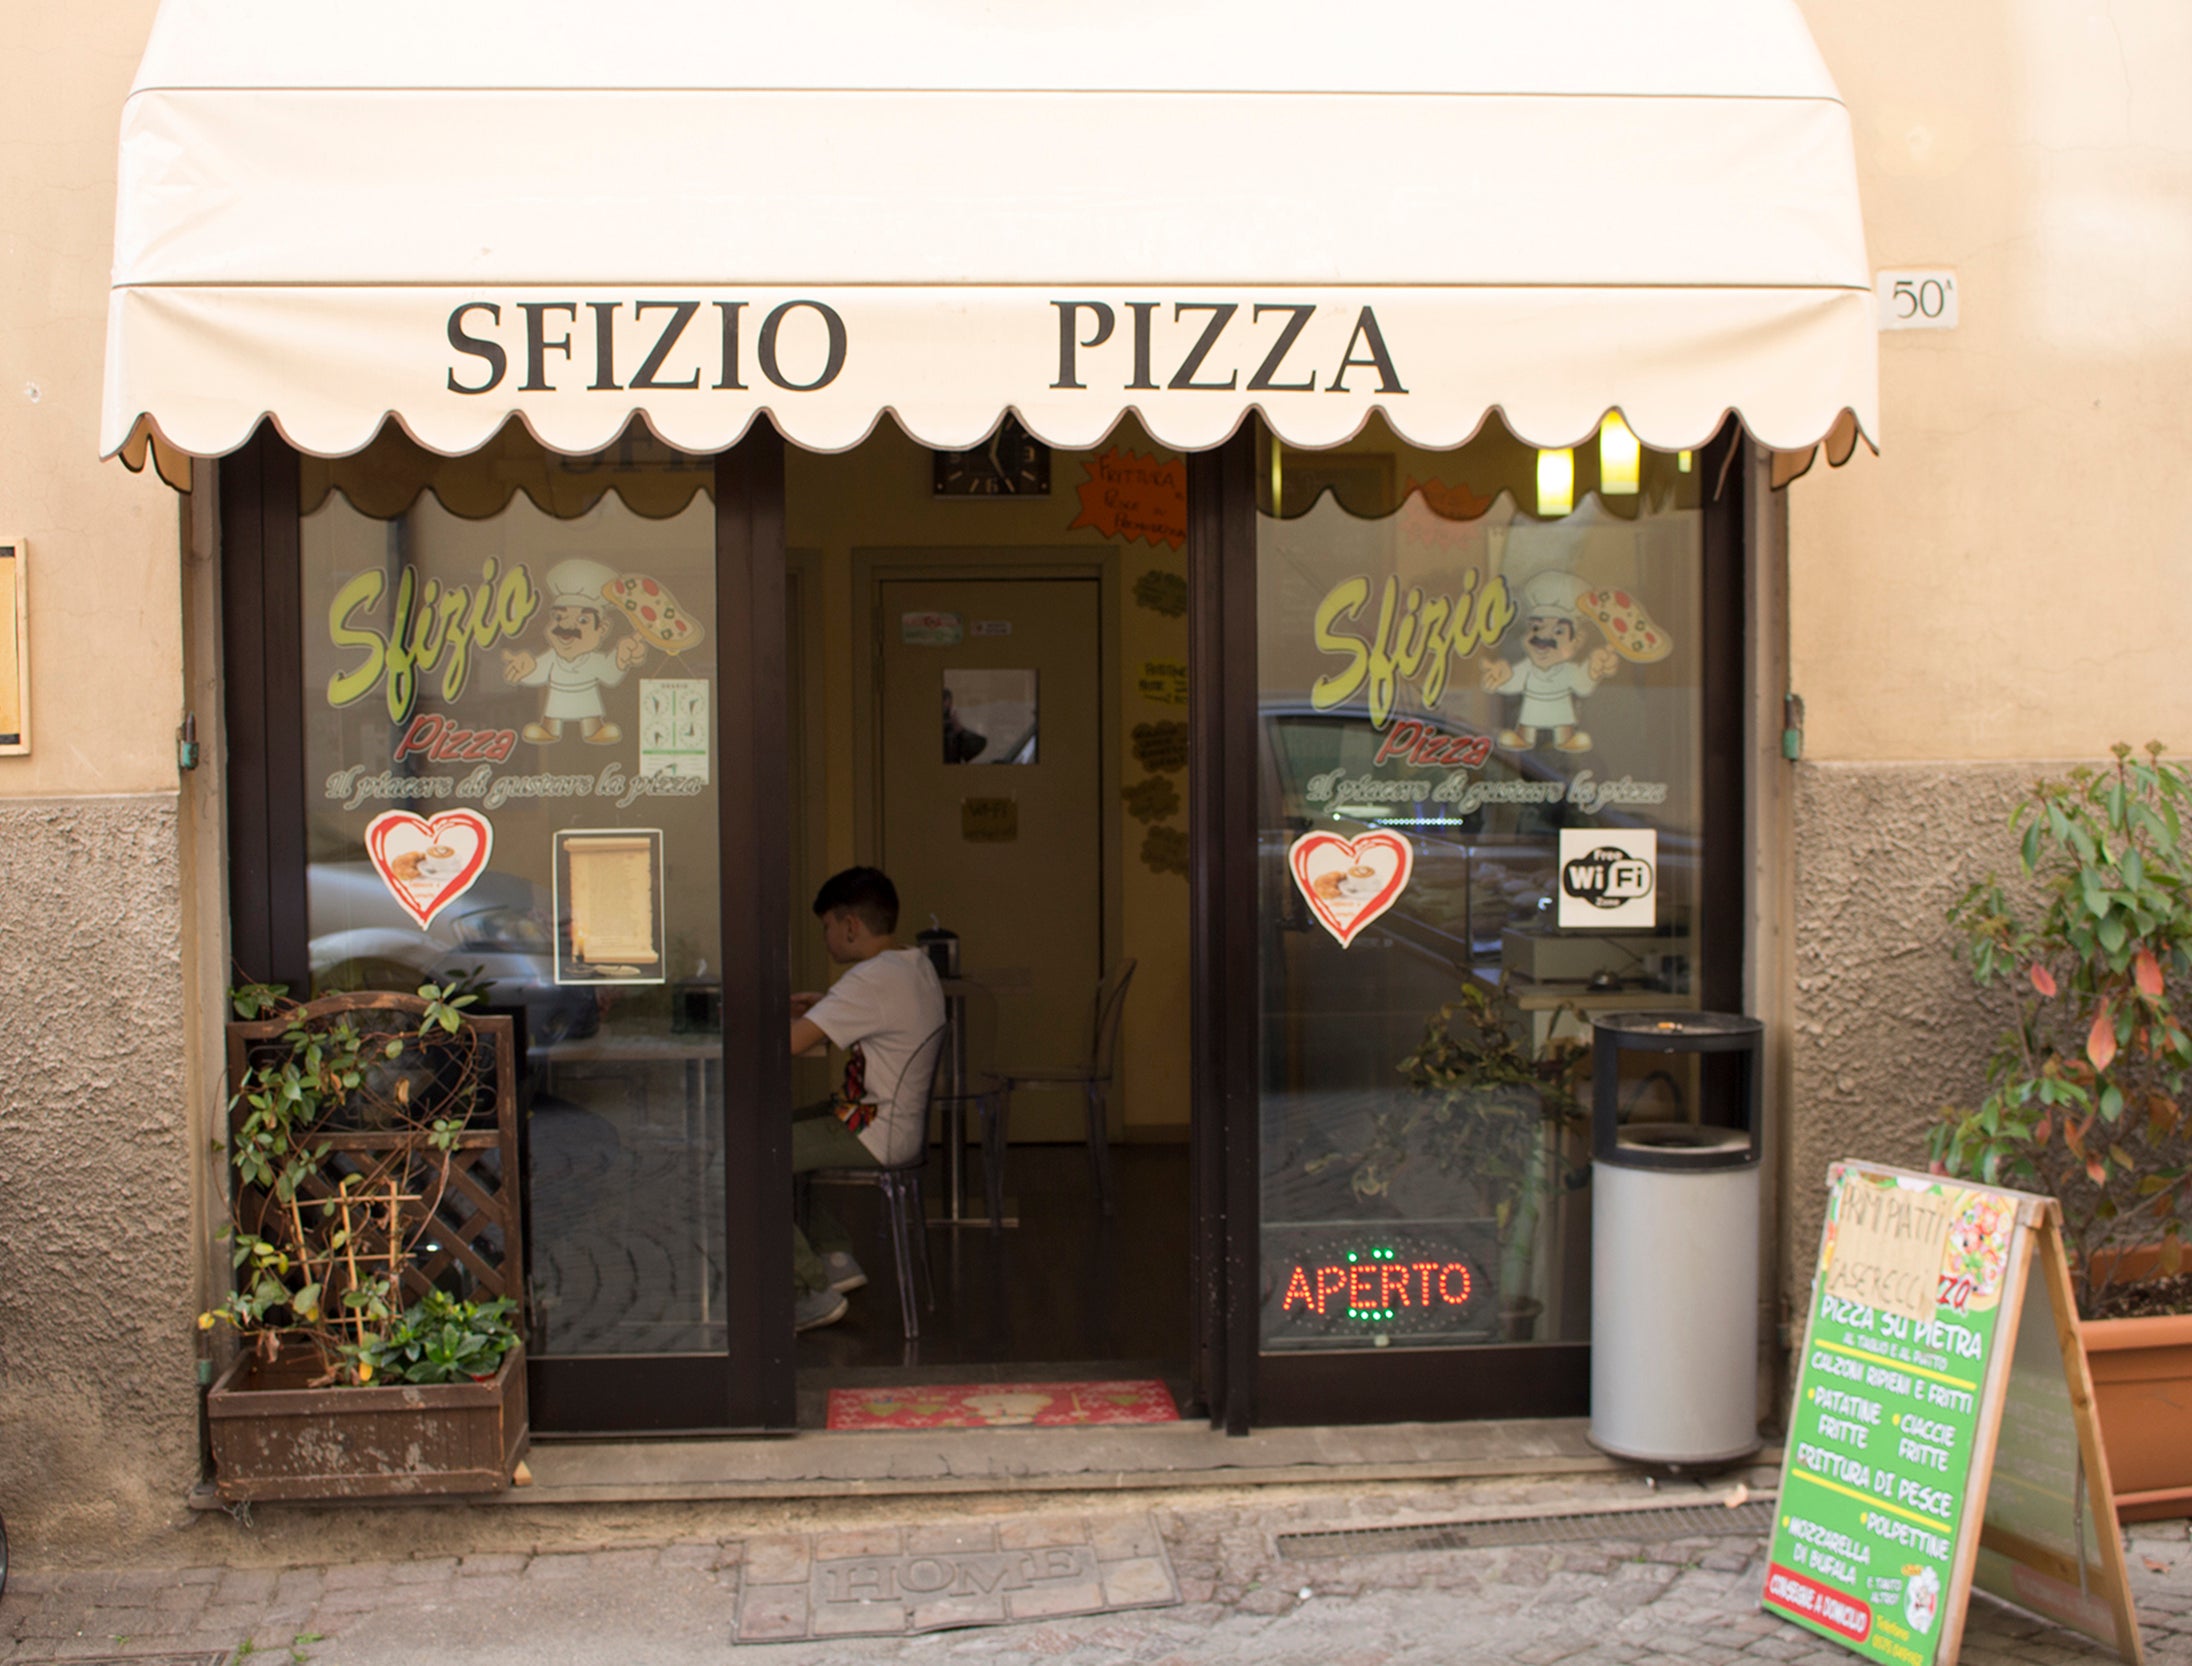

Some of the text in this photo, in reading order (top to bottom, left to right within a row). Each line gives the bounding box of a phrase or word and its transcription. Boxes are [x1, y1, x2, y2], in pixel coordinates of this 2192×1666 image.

[446, 300, 1410, 395] SFIZIO PIZZA
[328, 556, 542, 725] Sfizio
[1311, 566, 1519, 730] Sfizio
[394, 713, 518, 764] Pizza
[1373, 718, 1494, 769] Pizza
[344, 770, 454, 811] piacere
[456, 763, 493, 799] di
[483, 772, 594, 811] gustare
[595, 761, 626, 797] la
[616, 770, 703, 809] pizza
[1282, 1261, 1472, 1315] APERTO
[1820, 1293, 1983, 1361] PIZZA SU PIETRA
[1811, 1351, 1864, 1381] CALZONI
[1914, 1379, 1925, 1400] E
[1927, 1383, 1974, 1415] FRITTI
[1813, 1384, 1882, 1425] PATATINE
[1817, 1413, 1870, 1449] FRITTE
[1897, 1436, 1950, 1472] FRITTE
[1900, 1412, 1957, 1448] CIACCIE
[1796, 1442, 1955, 1519] FRITTURA DI PESCE
[1788, 1515, 1871, 1565] MOZZARELLA
[1866, 1511, 1951, 1562] POLPETTINE
[826, 1549, 1084, 1604] HOME
[1793, 1542, 1858, 1586] DI BUFALA
